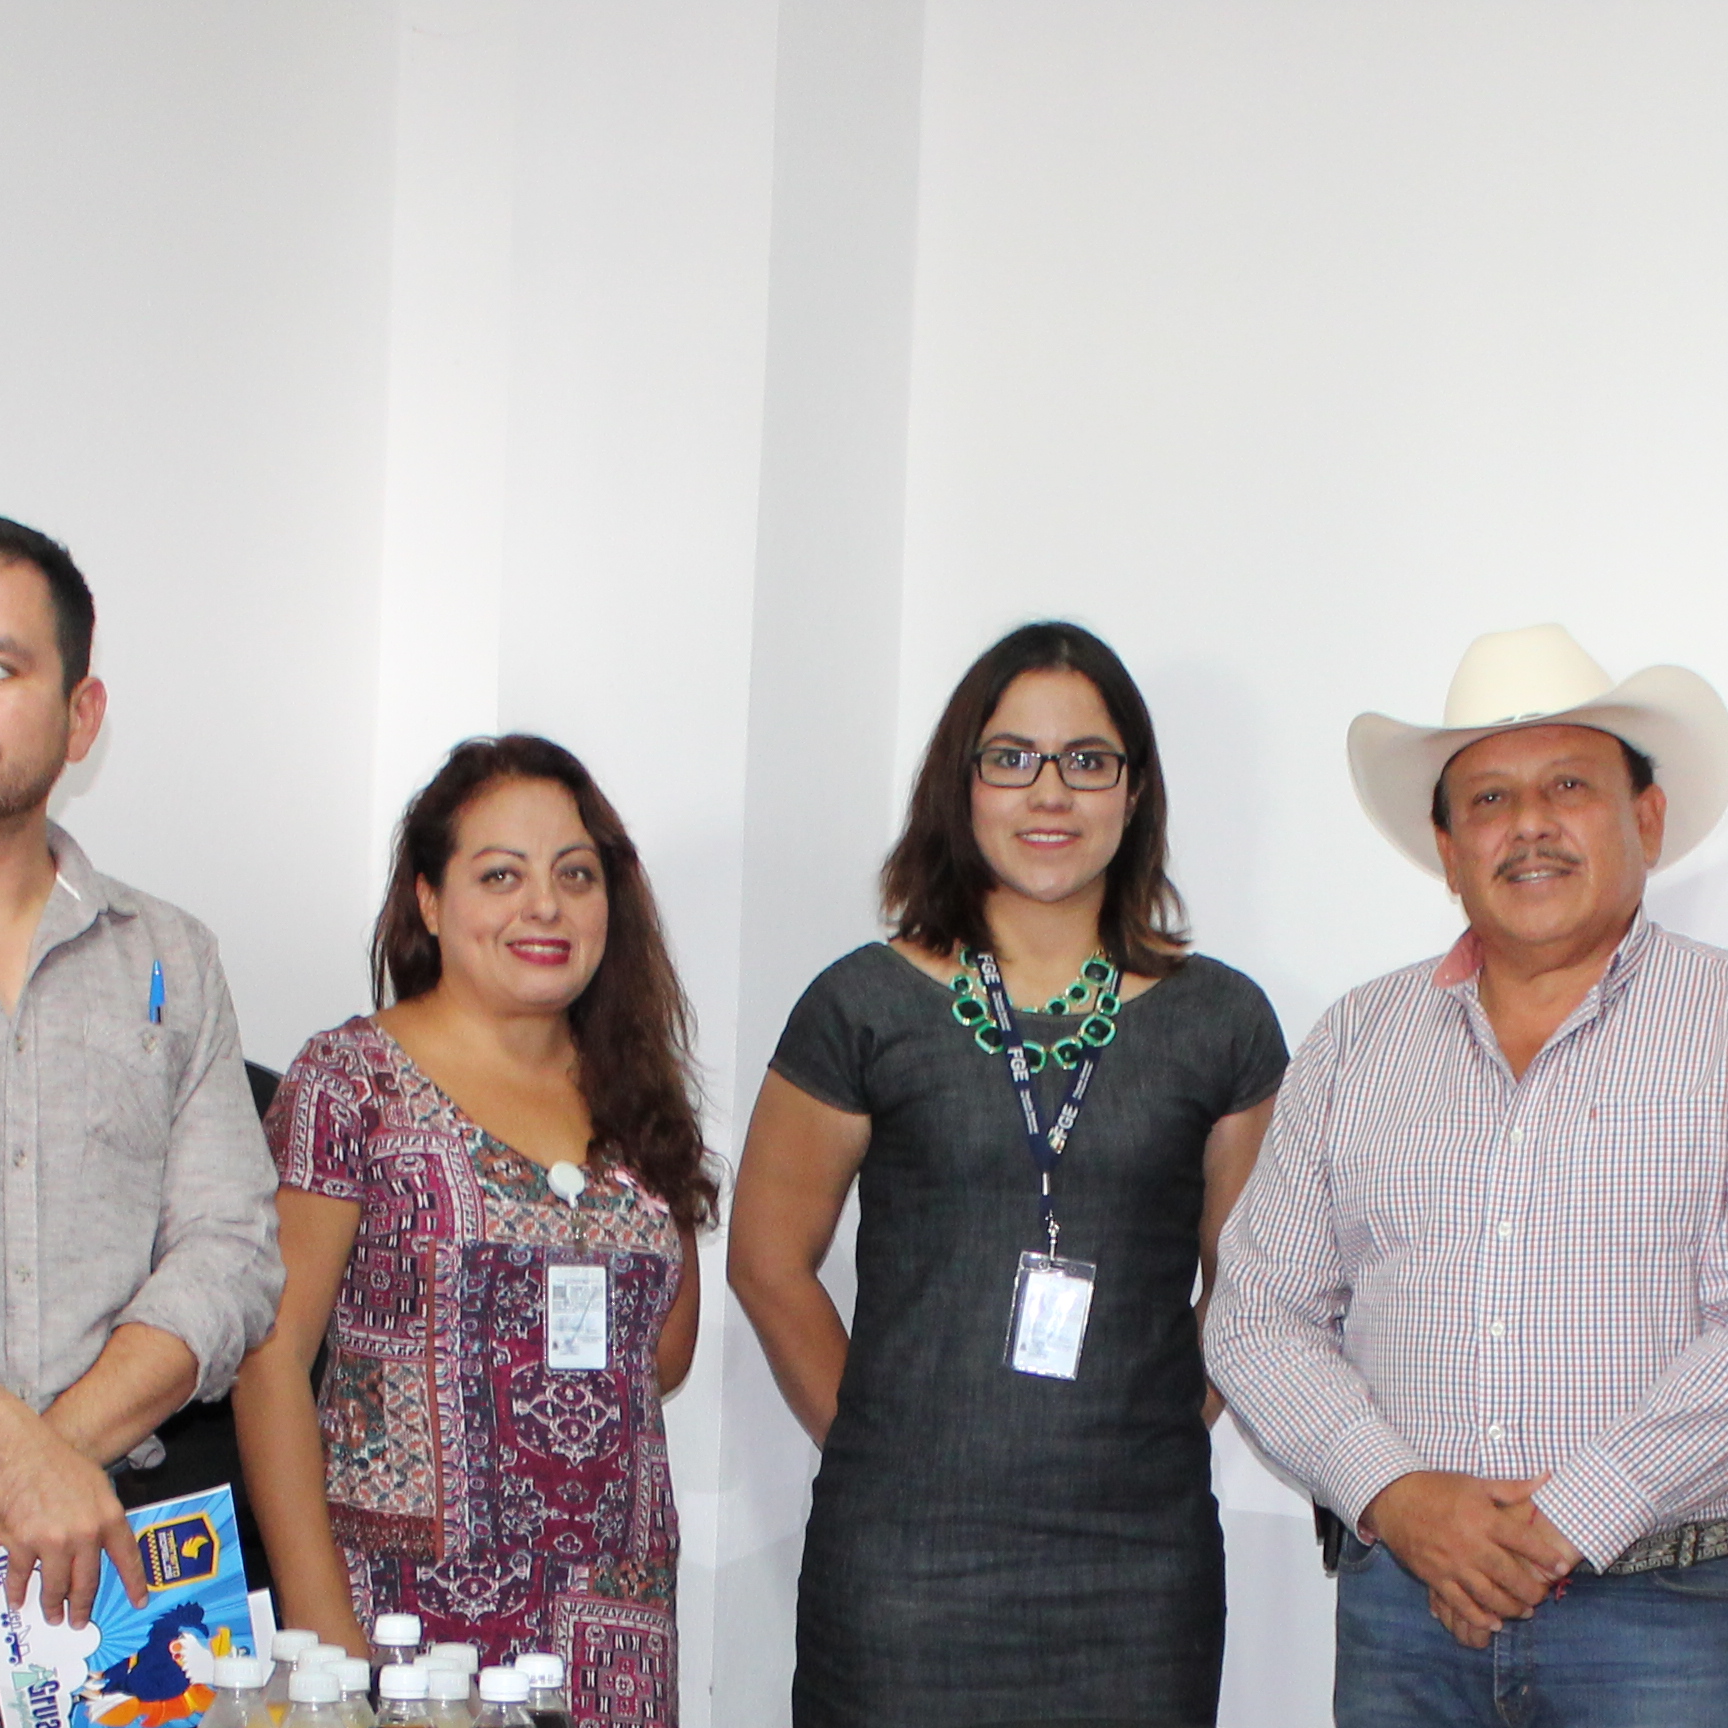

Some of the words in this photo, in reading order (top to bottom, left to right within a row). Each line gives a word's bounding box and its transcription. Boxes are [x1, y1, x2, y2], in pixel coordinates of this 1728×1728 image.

[978, 953, 1000, 985] FGE
[1007, 1047, 1029, 1082] FGE
[1054, 1102, 1079, 1140] FGE
